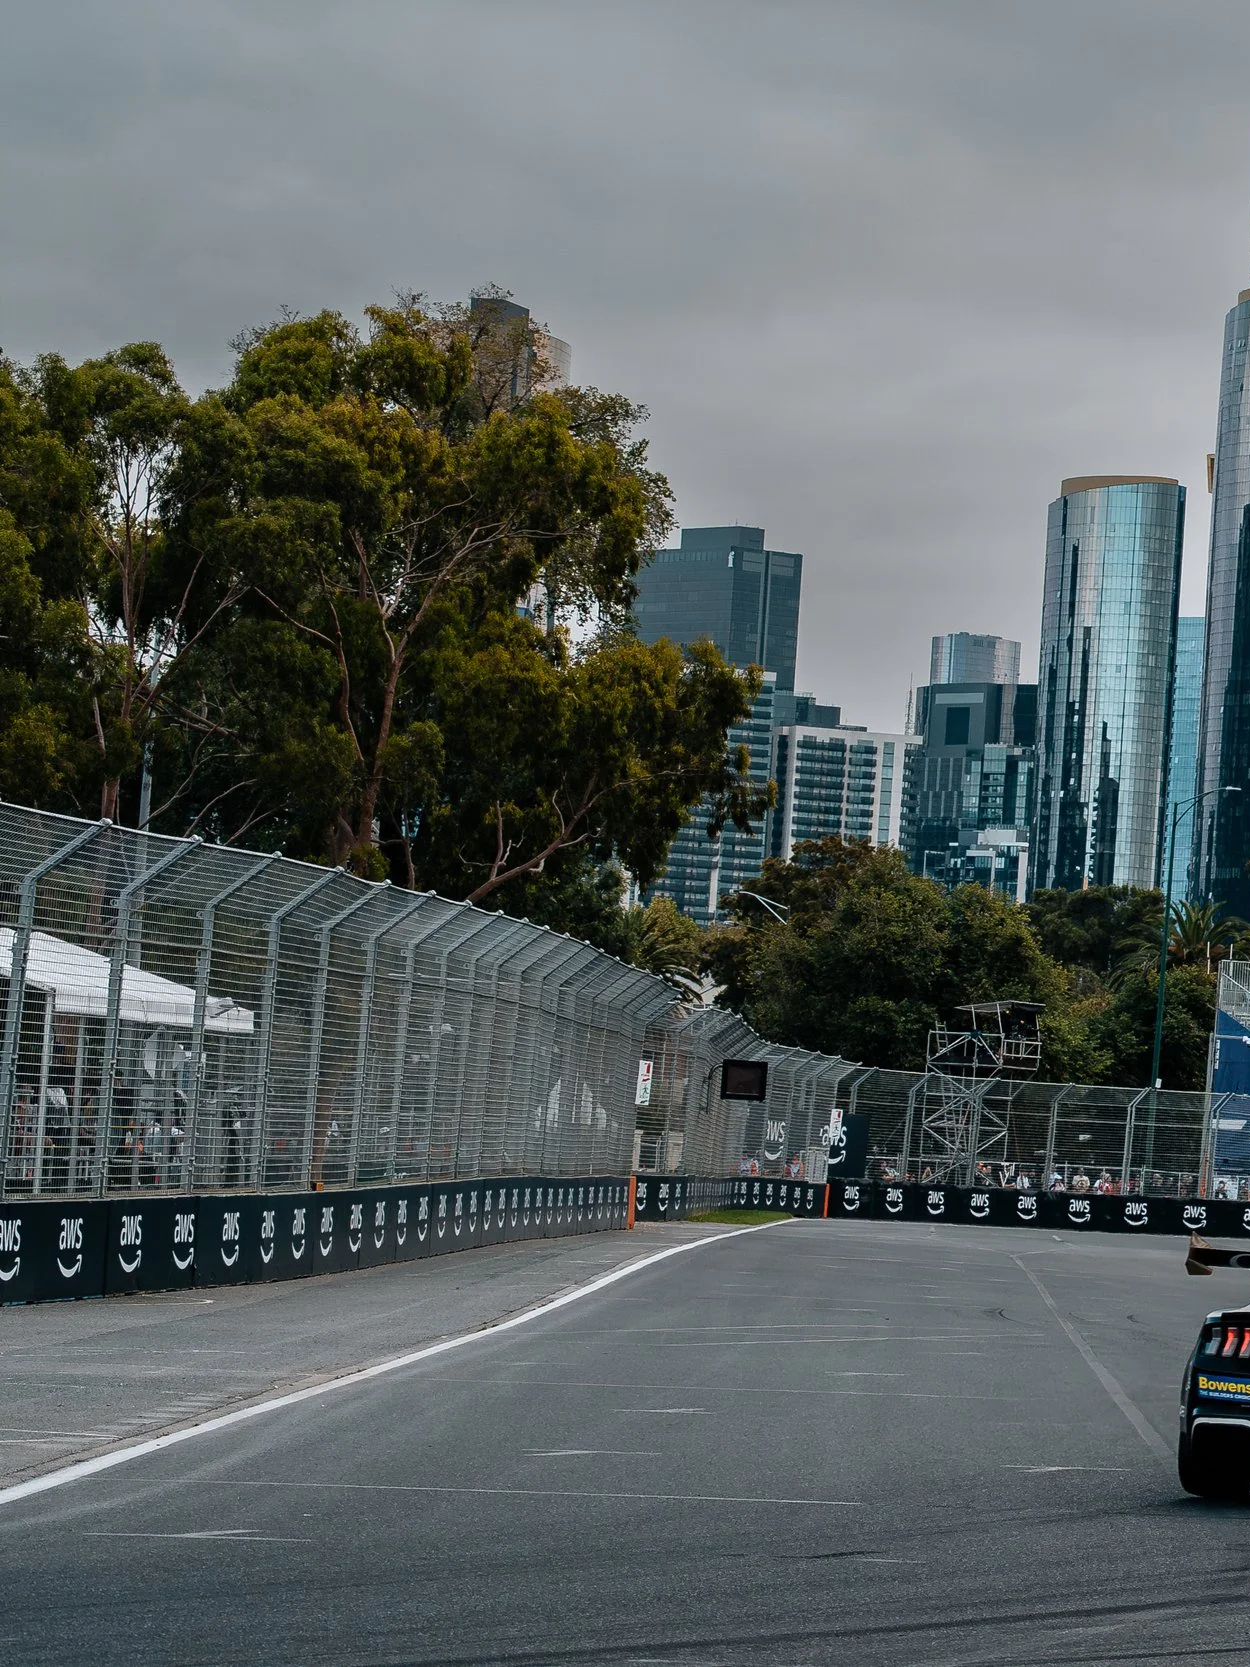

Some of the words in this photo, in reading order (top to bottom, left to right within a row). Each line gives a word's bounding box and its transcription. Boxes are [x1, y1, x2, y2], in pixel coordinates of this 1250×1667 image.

[845, 1186, 859, 1199] aws
[887, 1188, 902, 1202] aws
[928, 1191, 944, 1205] aws
[971, 1194, 989, 1208] aws
[1018, 1196, 1036, 1211] aws
[350, 1204, 363, 1229] aws
[375, 1201, 386, 1226] aws
[398, 1200, 408, 1224] aws
[418, 1197, 428, 1220] aws
[1069, 1199, 1090, 1214] aws
[1126, 1203, 1148, 1217] aws
[1183, 1206, 1206, 1220] aws
[120, 1215, 142, 1246] aws
[174, 1214, 194, 1243] aws
[223, 1212, 239, 1241] aws
[262, 1211, 274, 1238] aws
[293, 1208, 306, 1235] aws
[321, 1207, 333, 1233] aws
[59, 1218, 83, 1250] aws
